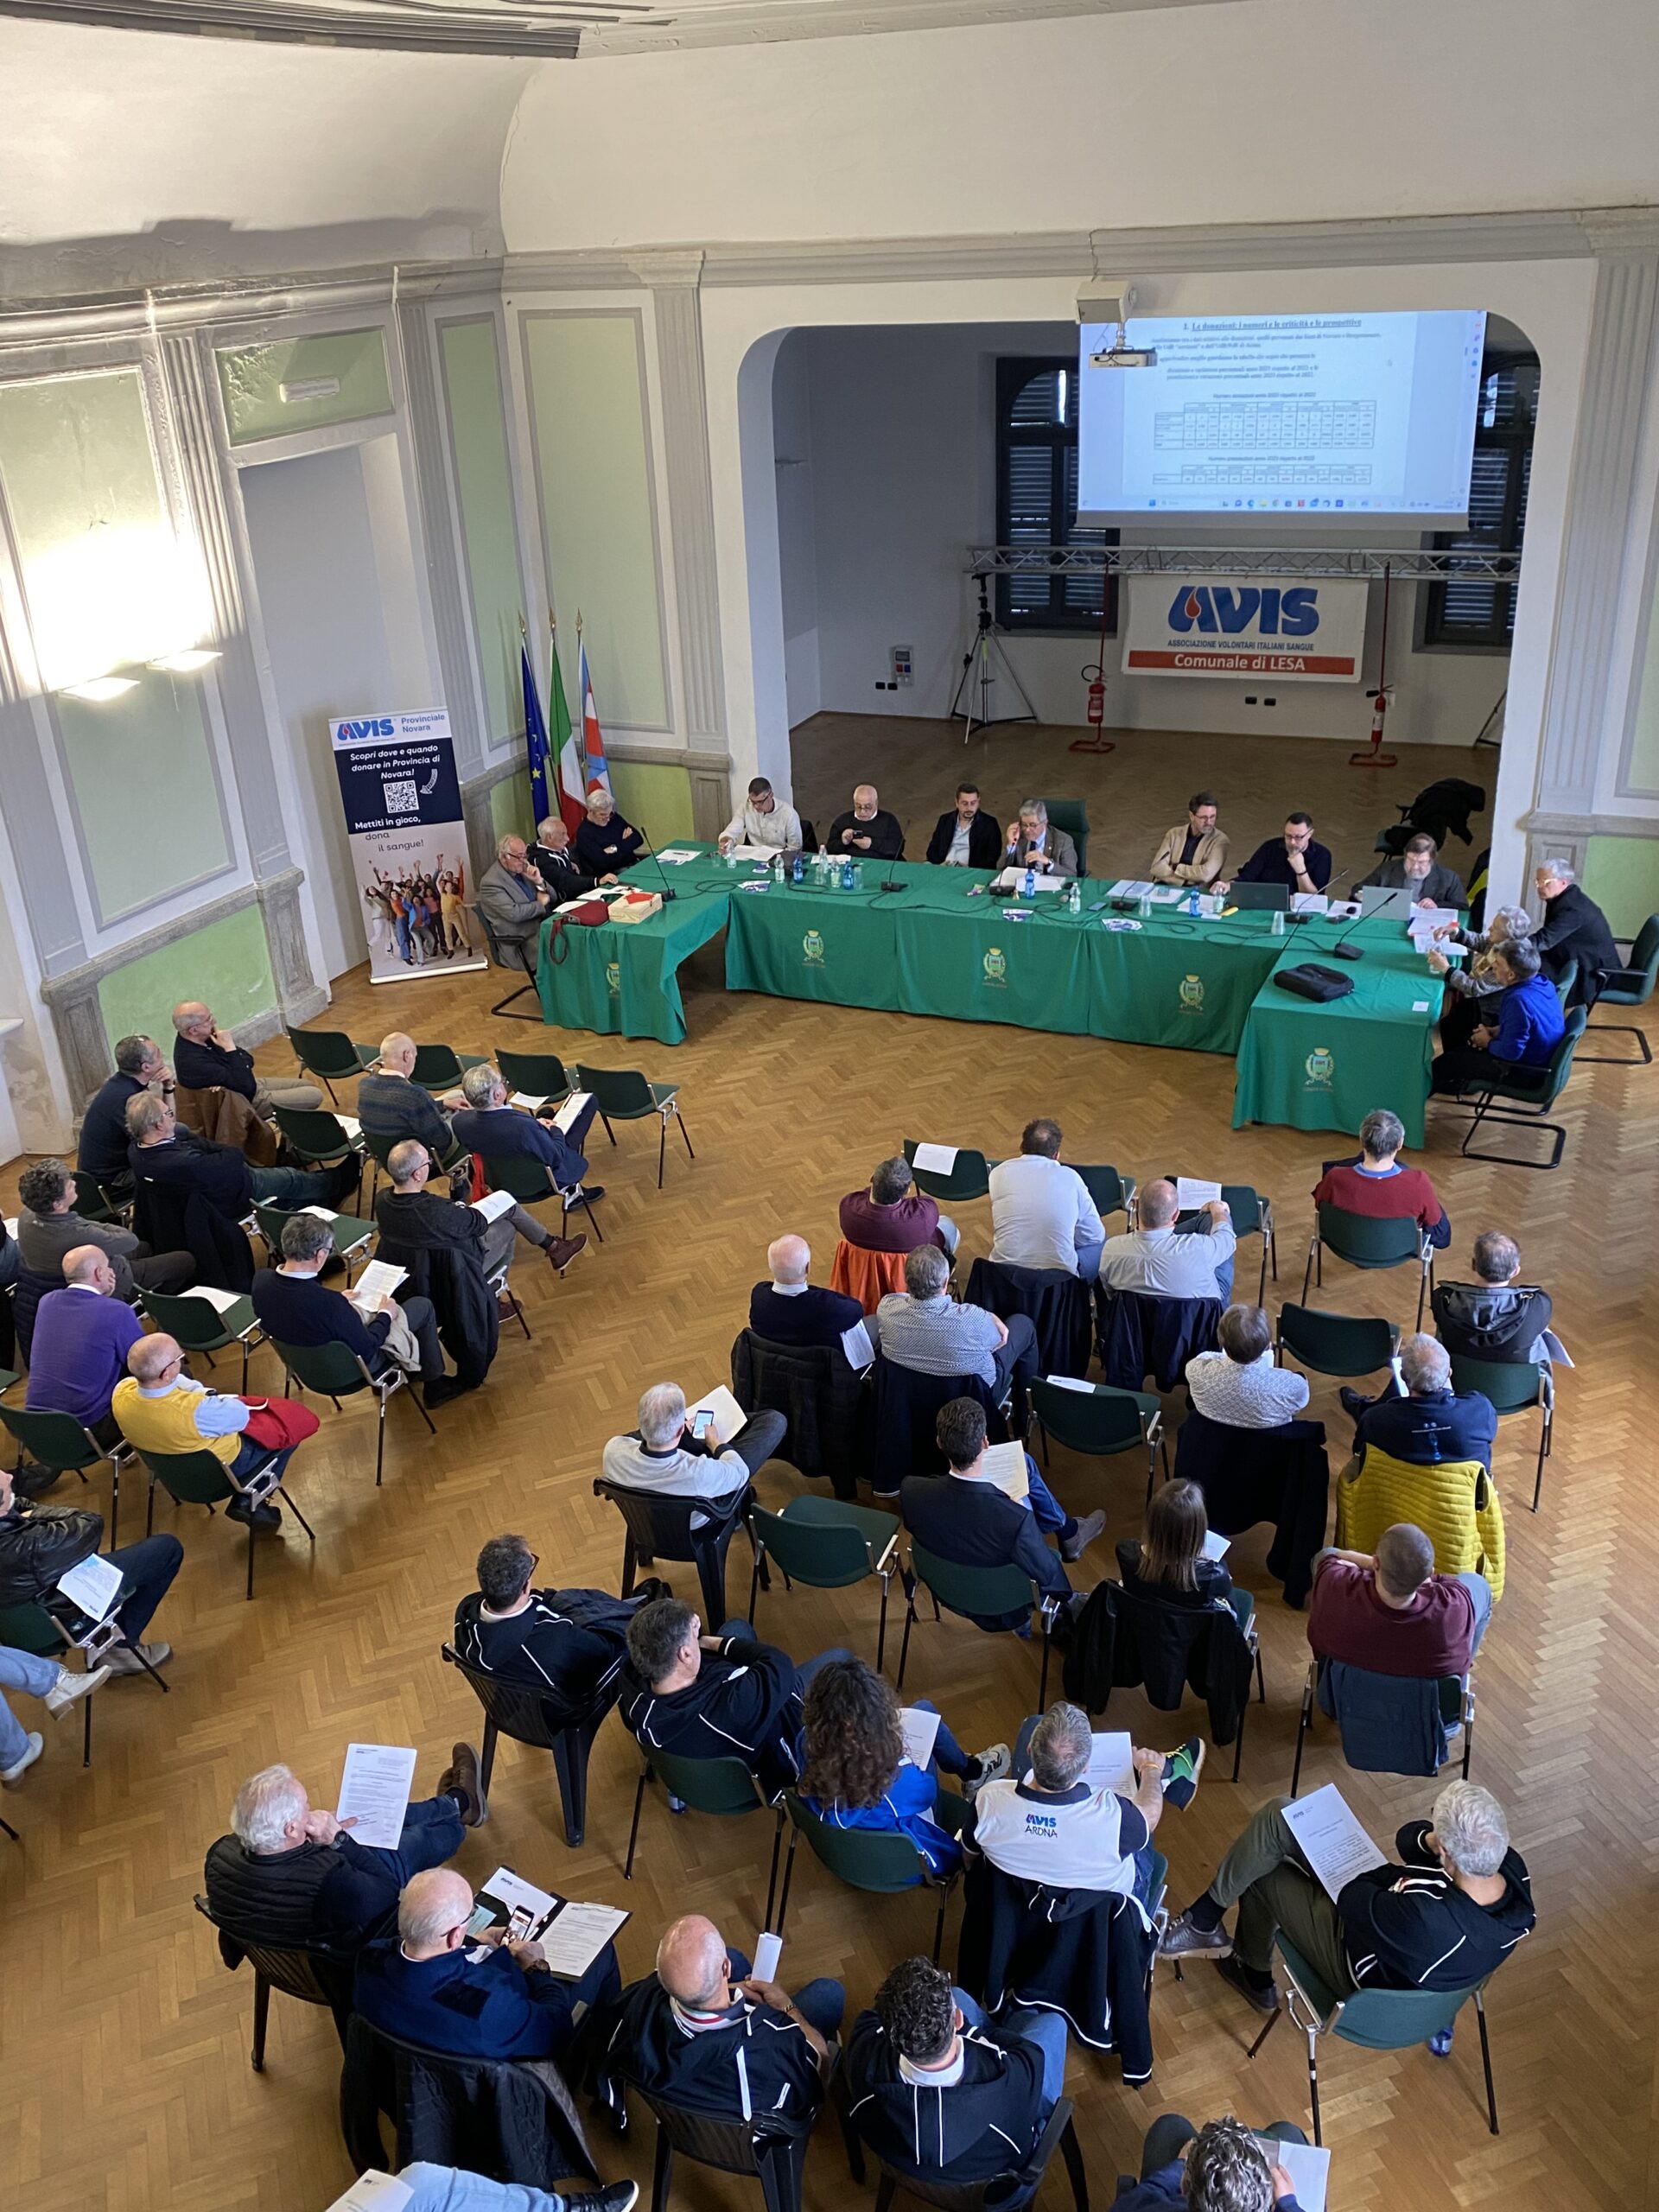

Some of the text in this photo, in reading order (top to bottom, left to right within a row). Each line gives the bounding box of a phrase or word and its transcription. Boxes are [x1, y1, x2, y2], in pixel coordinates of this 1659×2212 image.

[1167, 585, 1320, 637] AVIS
[1167, 639, 1314, 652] ASSOCIAZIONE VOLONTARI ITALIANI SANGUE
[1174, 653, 1306, 671] Comunale di LESA
[337, 714, 445, 741] AVIS Provinciale
[402, 724, 430, 733] Novara
[350, 751, 377, 761] Scopri
[378, 748, 398, 758] dove
[406, 744, 439, 756] quando
[351, 762, 382, 772] donare
[392, 756, 430, 767] Provincia
[432, 754, 441, 763] di
[380, 768, 415, 779] Novara!
[354, 816, 422, 830] Mettiti in gioco,
[365, 831, 390, 841] dona
[378, 839, 424, 852] il sangue!
[1026, 1814, 1057, 1827] AVIS
